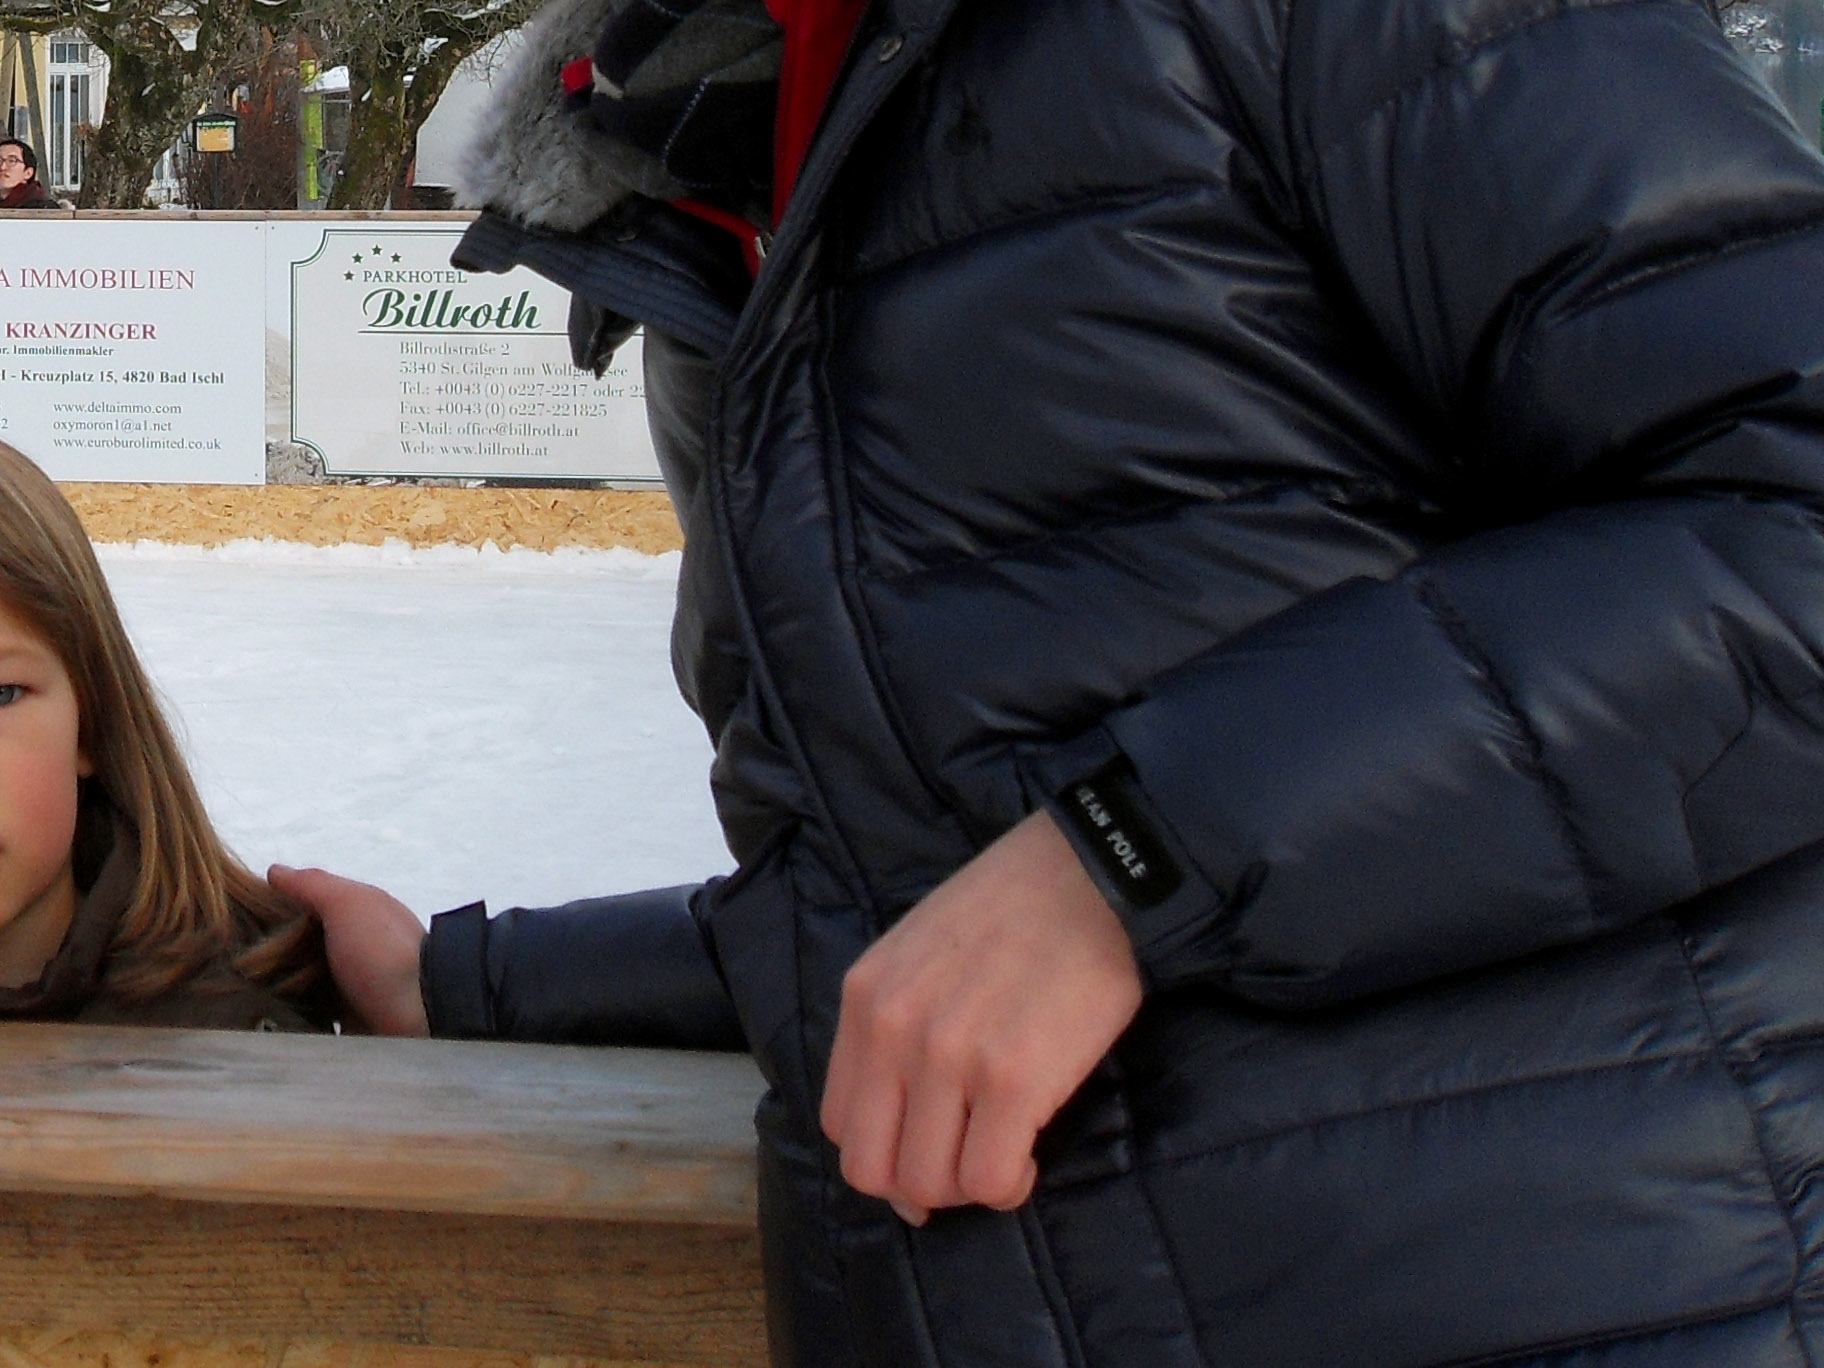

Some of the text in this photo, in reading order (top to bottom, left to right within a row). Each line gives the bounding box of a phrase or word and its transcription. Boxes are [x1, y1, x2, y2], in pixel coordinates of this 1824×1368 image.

[19, 268, 196, 291] IMMOBILIEN
[363, 270, 468, 284] PARKHOTEL
[362, 287, 543, 331] Billroth
[5, 321, 159, 342] KRANZINGER
[12, 345, 115, 358] Immobilienmakler
[399, 341, 511, 357] Billrothstraße 2
[20, 368, 95, 386] Kreuzplatz
[98, 370, 119, 385] 15,
[121, 370, 155, 385] 4820
[158, 370, 188, 385] Bad
[190, 370, 226, 385] Ischl
[399, 360, 436, 375] 5340
[440, 362, 460, 376] St.
[462, 362, 509, 379] Gilgen
[513, 365, 536, 376] am
[399, 381, 430, 396] Tel.:
[434, 383, 481, 398] +0043
[484, 382, 505, 399] (0)
[508, 383, 588, 398] 6227-2217
[593, 384, 625, 398] oder
[53, 401, 183, 415] www.deltaimmo.com
[399, 401, 608, 419] Fax: +0043 (0) 6227-221825
[399, 421, 580, 438] E-Mail: office@billroth.at
[53, 436, 222, 451] www.euroburolimited.co.uk
[400, 441, 549, 457] Web: www.billroth.at
